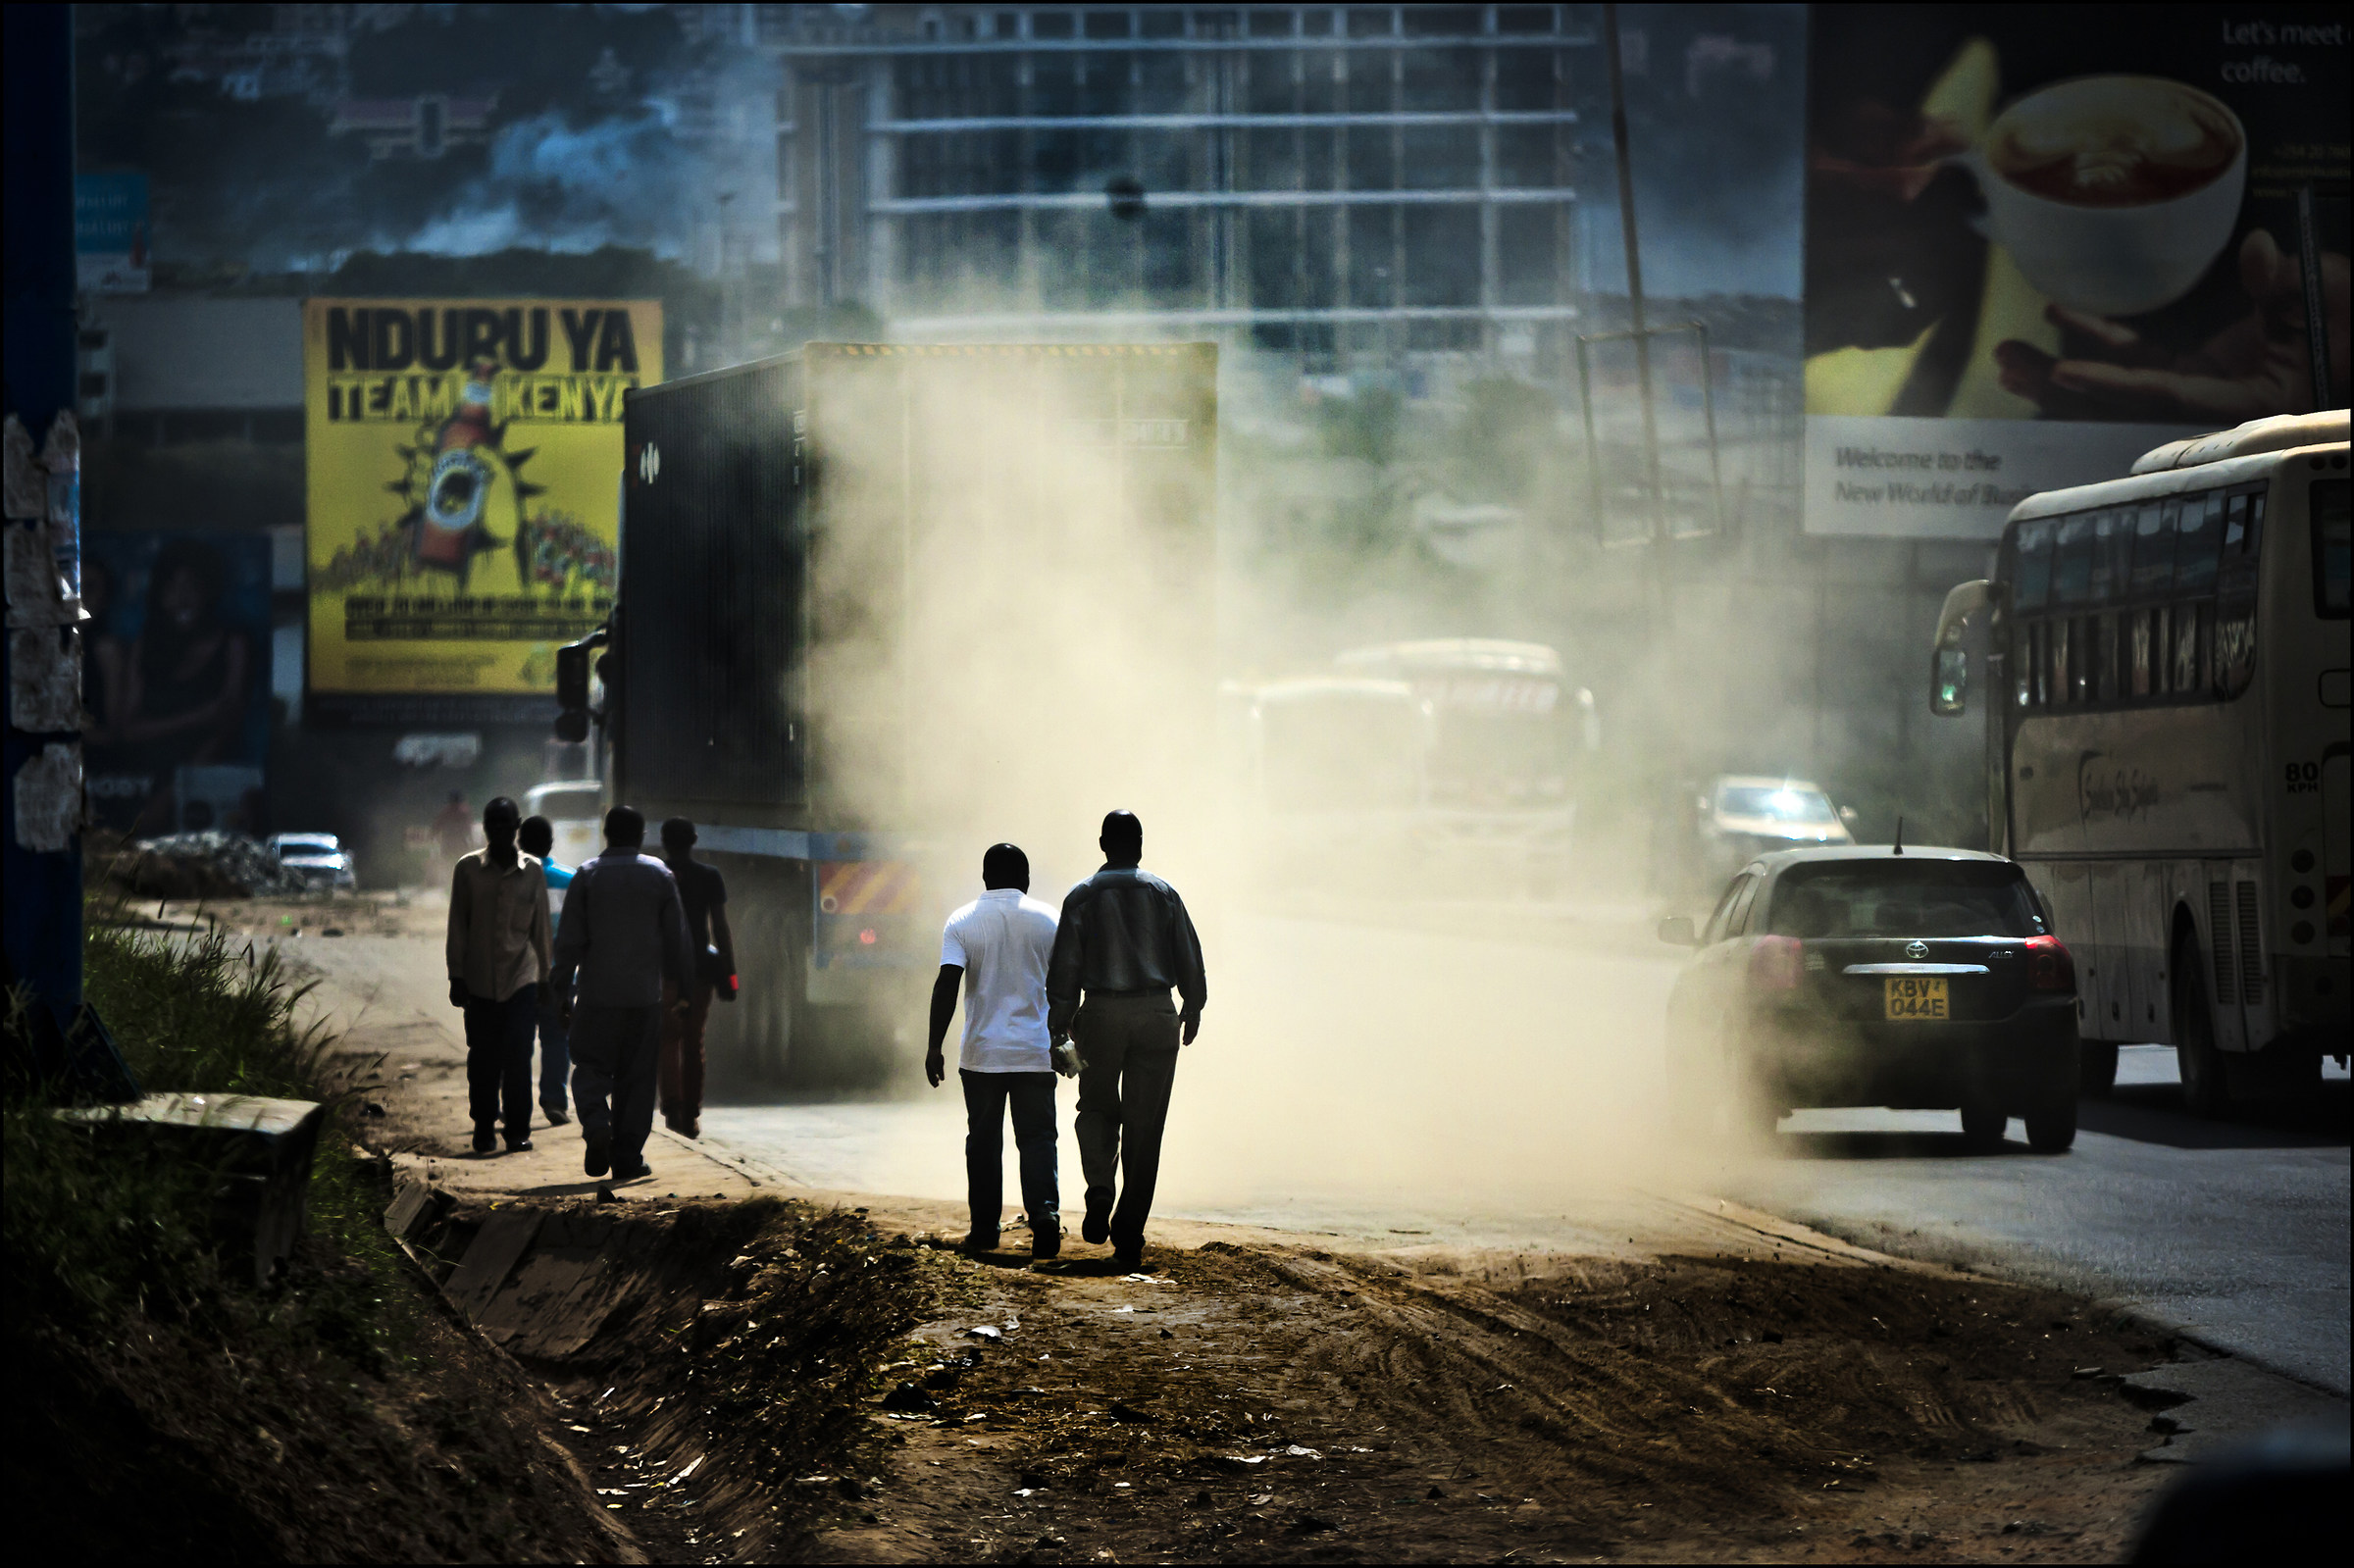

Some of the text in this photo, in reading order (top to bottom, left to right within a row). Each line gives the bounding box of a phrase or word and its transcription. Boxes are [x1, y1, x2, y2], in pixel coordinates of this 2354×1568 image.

[2222, 19, 2276, 45] Let's
[2280, 22, 2343, 45] meet
[2221, 55, 2306, 83] coffee.
[329, 306, 551, 372] NDURU
[559, 307, 640, 373] YA
[328, 376, 453, 422] TEAM
[1835, 446, 2003, 472] Welcome to the
[1835, 480, 1884, 504] New
[1887, 481, 1955, 505] World
[1955, 482, 1979, 505] of
[2285, 761, 2319, 782] 80
[2286, 782, 2319, 793] KPH
[1890, 979, 1930, 997] KBV
[1890, 998, 1945, 1017] 044E
